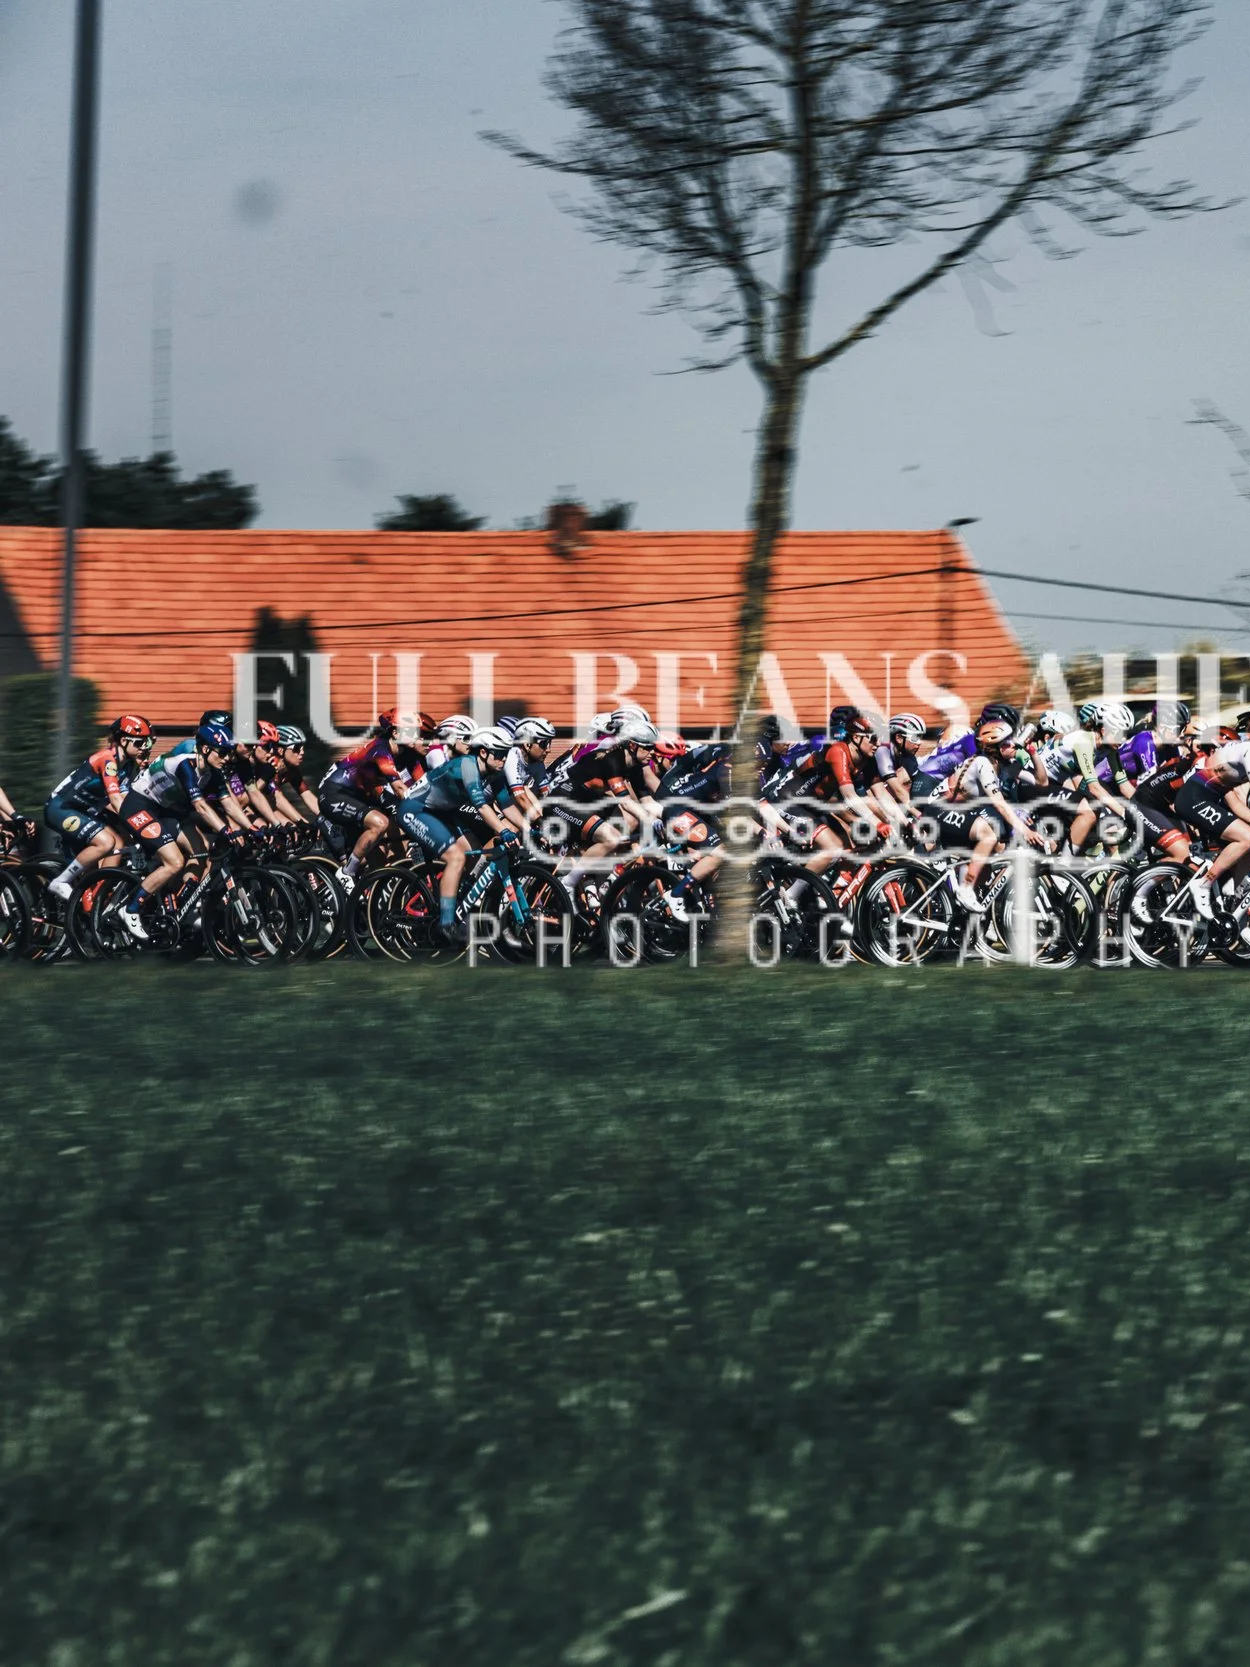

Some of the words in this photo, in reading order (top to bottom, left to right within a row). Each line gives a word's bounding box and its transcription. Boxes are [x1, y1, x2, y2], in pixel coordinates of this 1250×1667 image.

[1150, 771, 1178, 787] minimax
[553, 806, 583, 827] SHIMANO
[176, 873, 211, 922] LAPIERRE
[455, 865, 494, 920] FACTOR
[982, 875, 1007, 908] OLNAGO
